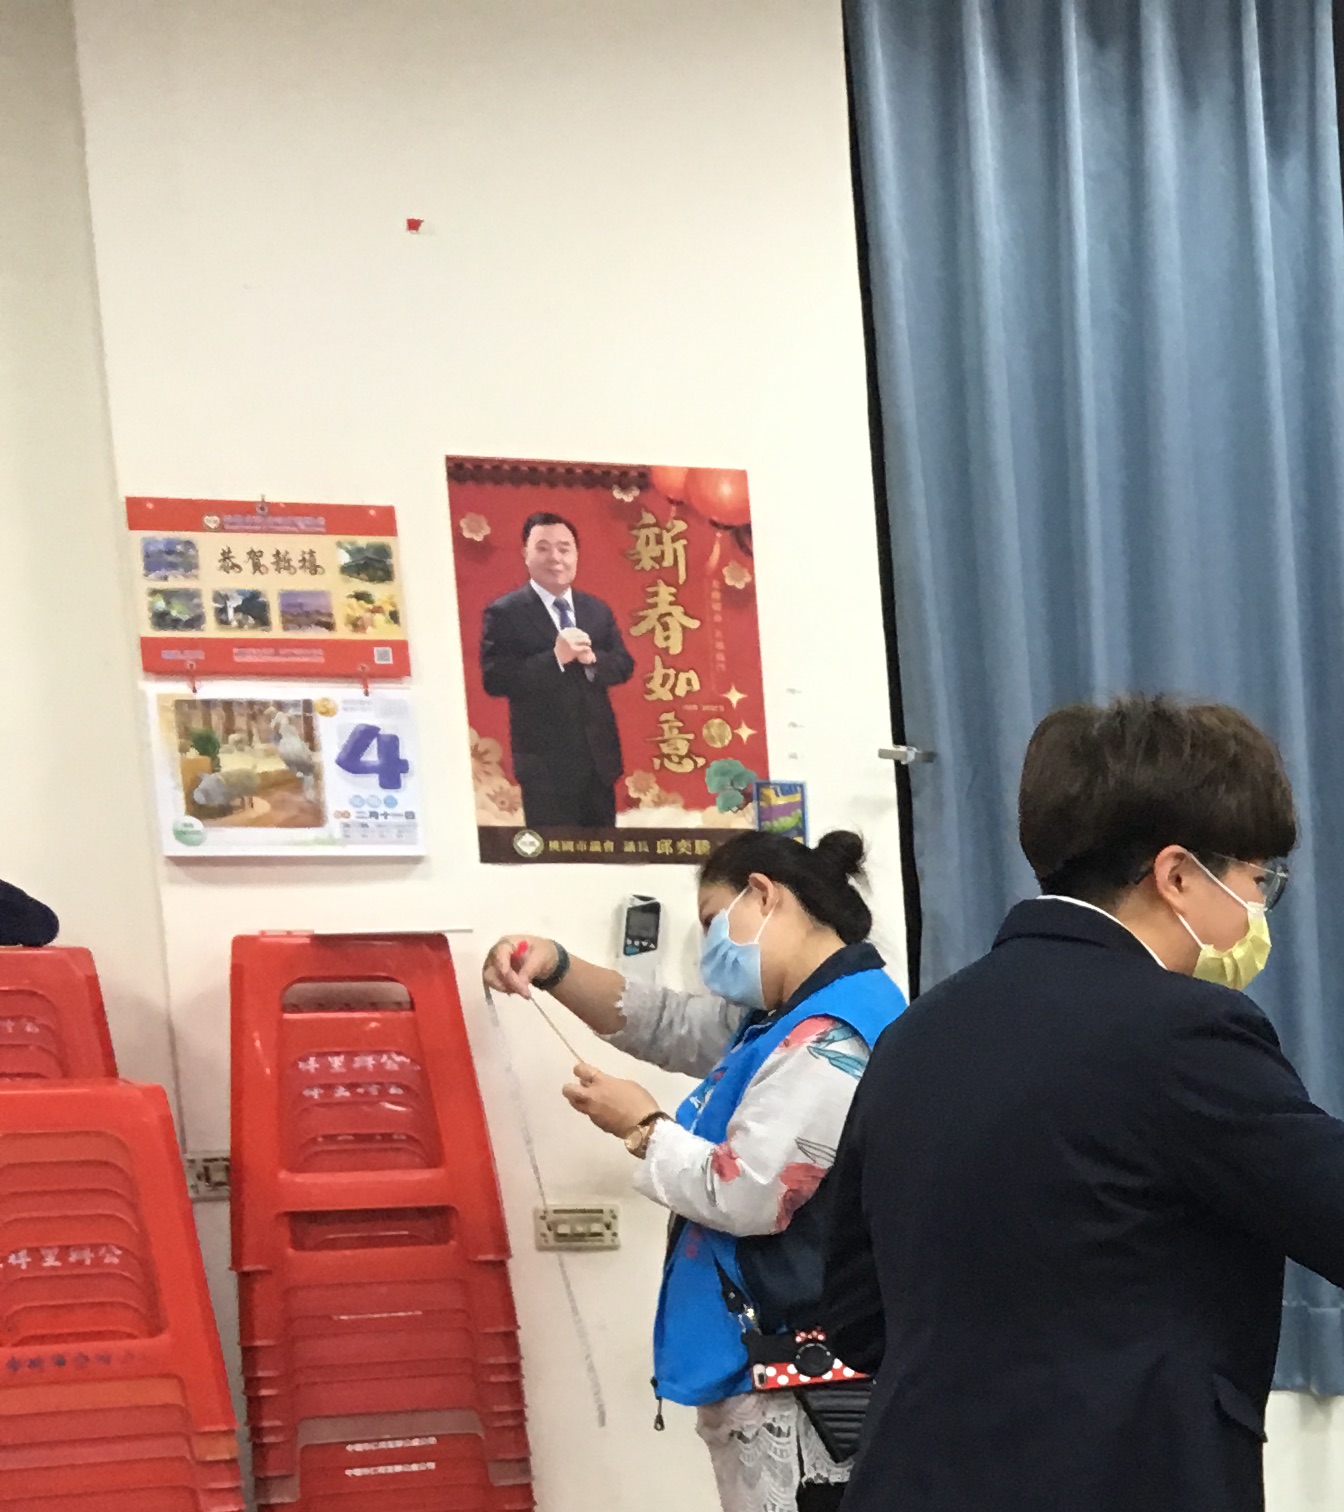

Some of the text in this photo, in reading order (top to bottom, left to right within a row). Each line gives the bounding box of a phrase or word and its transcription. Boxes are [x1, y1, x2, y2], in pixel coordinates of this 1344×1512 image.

[218, 545, 325, 576] 恭賀新禧
[624, 507, 706, 774] 新春如意
[334, 723, 409, 790] 4
